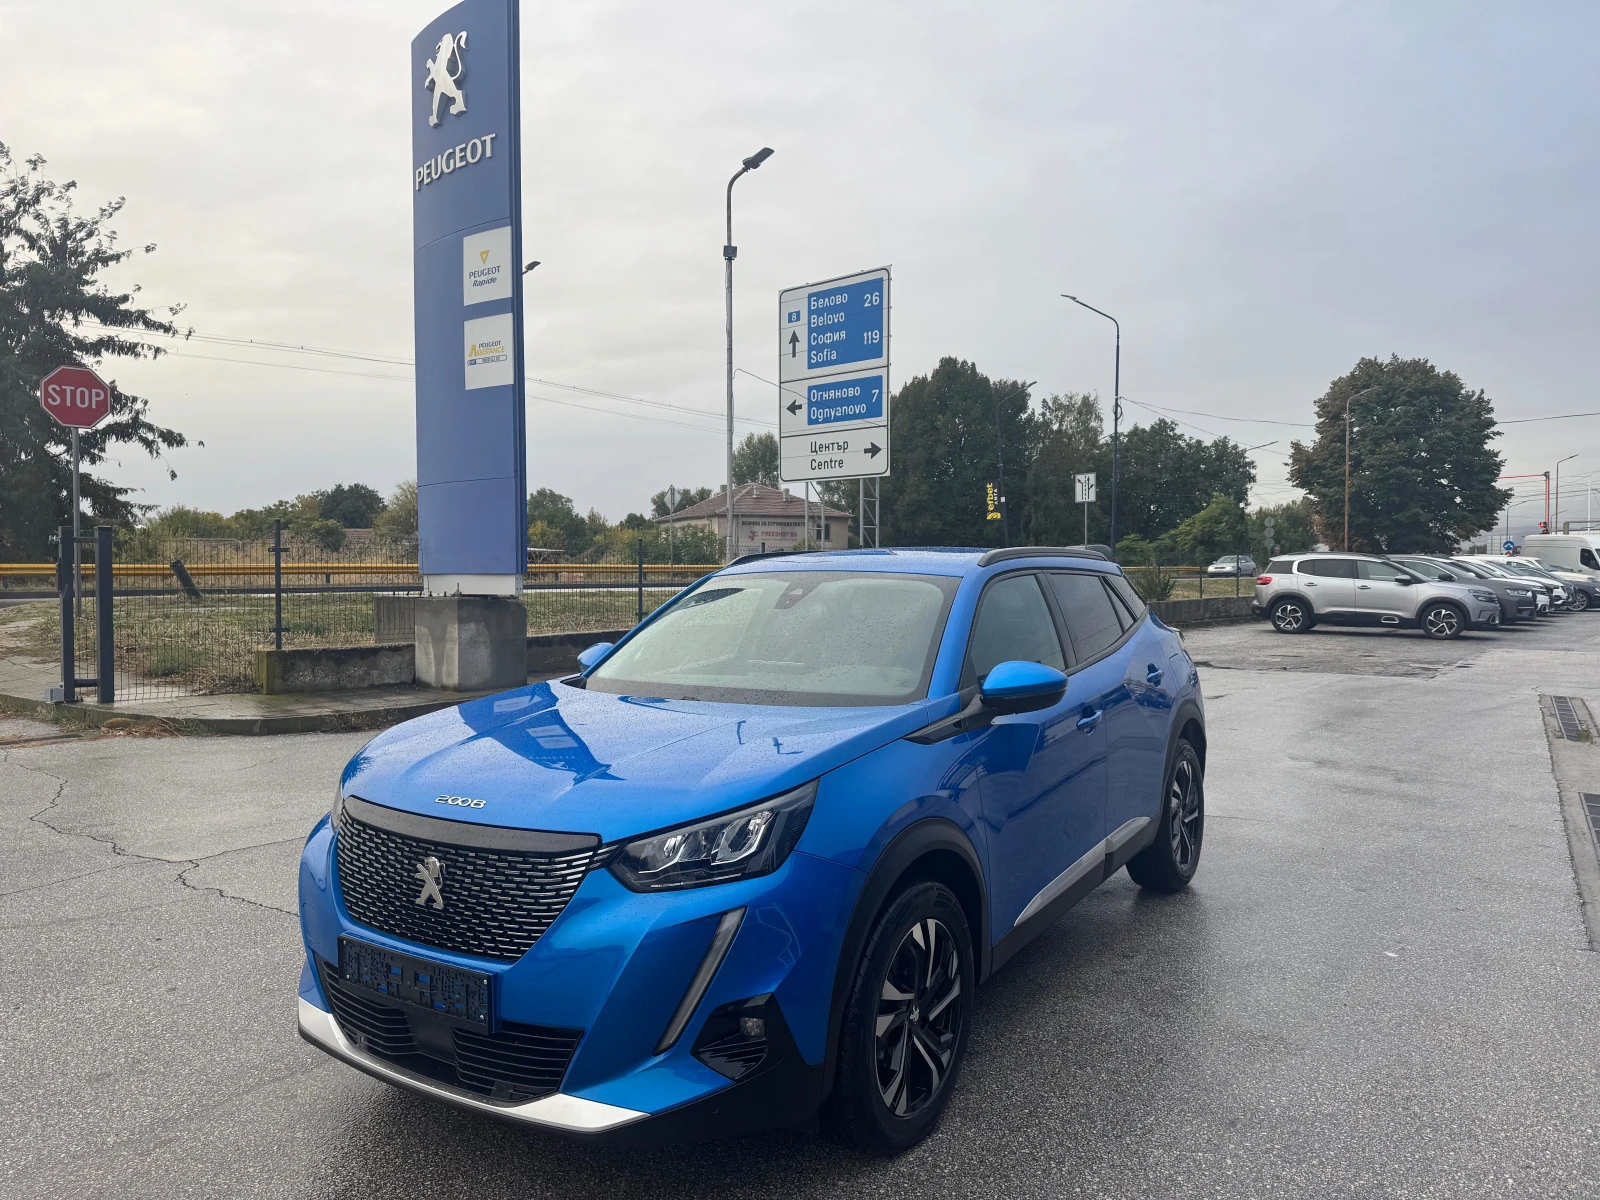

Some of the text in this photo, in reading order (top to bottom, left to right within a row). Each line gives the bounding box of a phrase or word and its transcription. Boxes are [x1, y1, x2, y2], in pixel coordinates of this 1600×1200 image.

[415, 133, 496, 191] PEUGEOT
[469, 266, 501, 279] PEUGEOT
[473, 277, 497, 287] Rapide
[811, 292, 880, 310] Белово 26
[791, 313, 797, 321] 8
[811, 312, 845, 328] Belovo
[479, 340, 501, 348] PEUGEOT
[811, 330, 880, 346] София 119
[811, 348, 837, 363] Sofia
[47, 384, 105, 409] STOP
[811, 386, 879, 403] Огняново 7
[811, 403, 867, 422] Ognyanovo
[810, 440, 849, 455] Център
[810, 458, 844, 471] Centre
[986, 483, 994, 511] efbet
[435, 794, 487, 809] 2008
